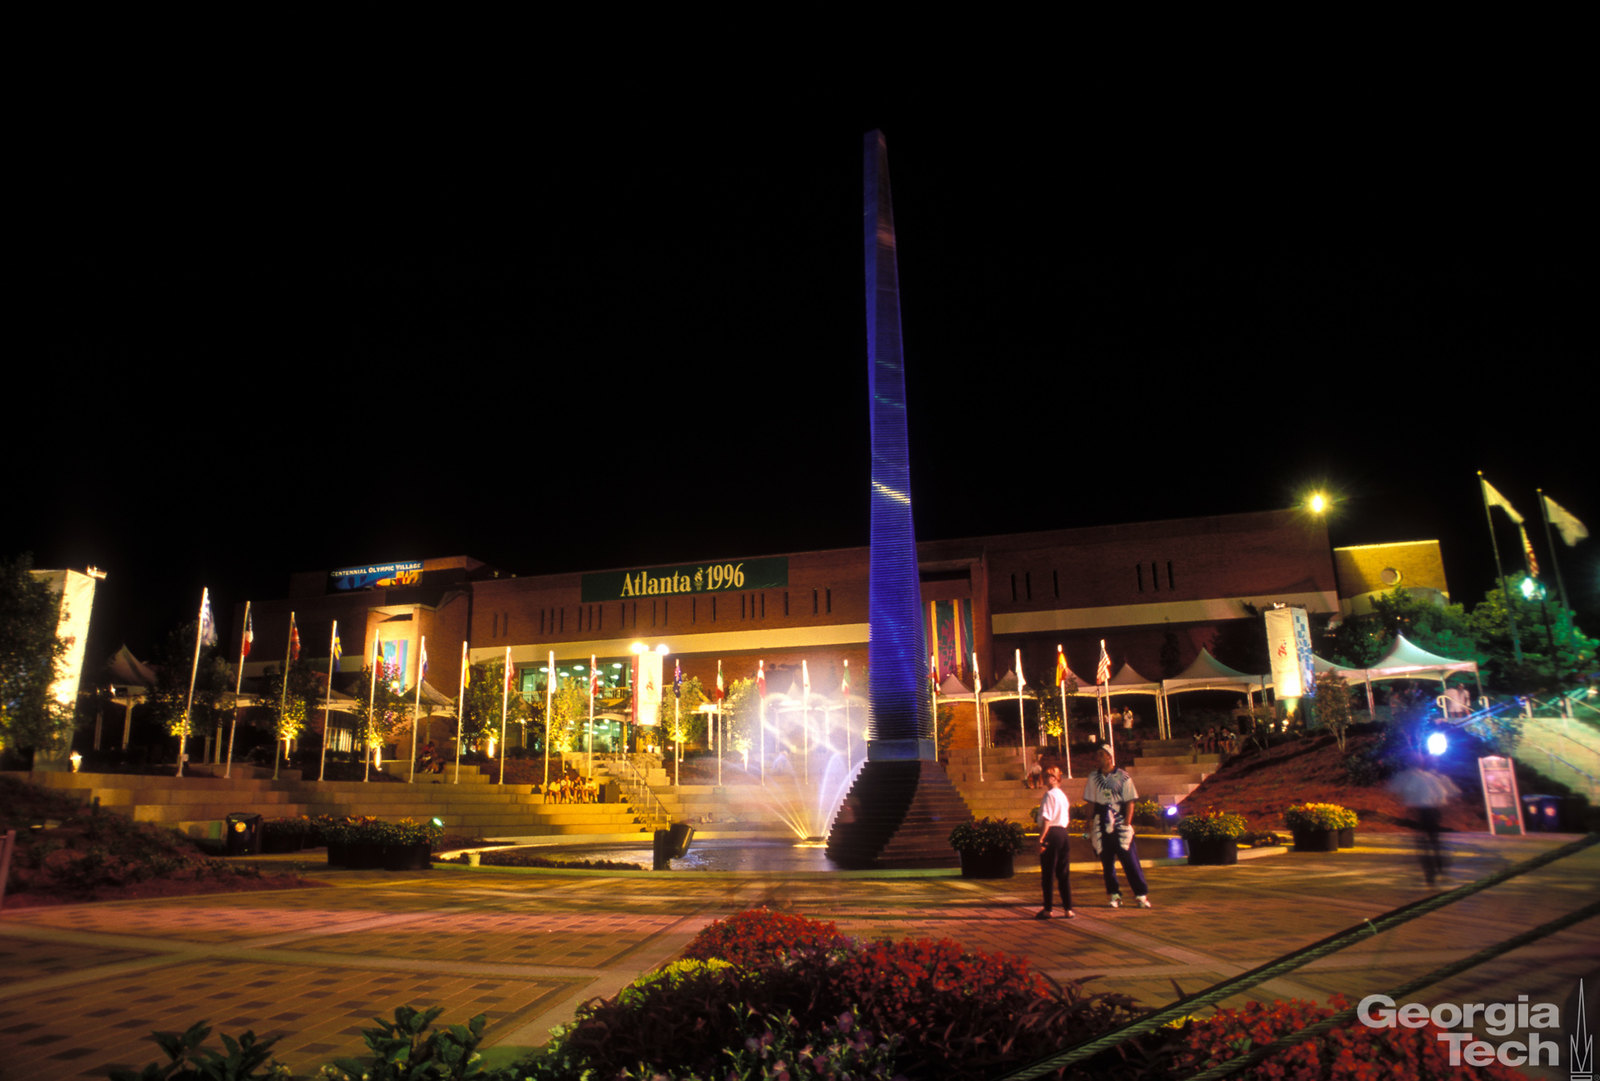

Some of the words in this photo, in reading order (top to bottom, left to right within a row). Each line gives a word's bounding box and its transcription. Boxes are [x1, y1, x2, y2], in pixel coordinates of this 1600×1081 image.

[331, 568, 367, 577] CENTENNIAL
[368, 564, 395, 573] OLYMPIC
[395, 563, 422, 571] VILLAGE
[620, 570, 692, 597] Atlanta
[705, 562, 745, 590] 1996
